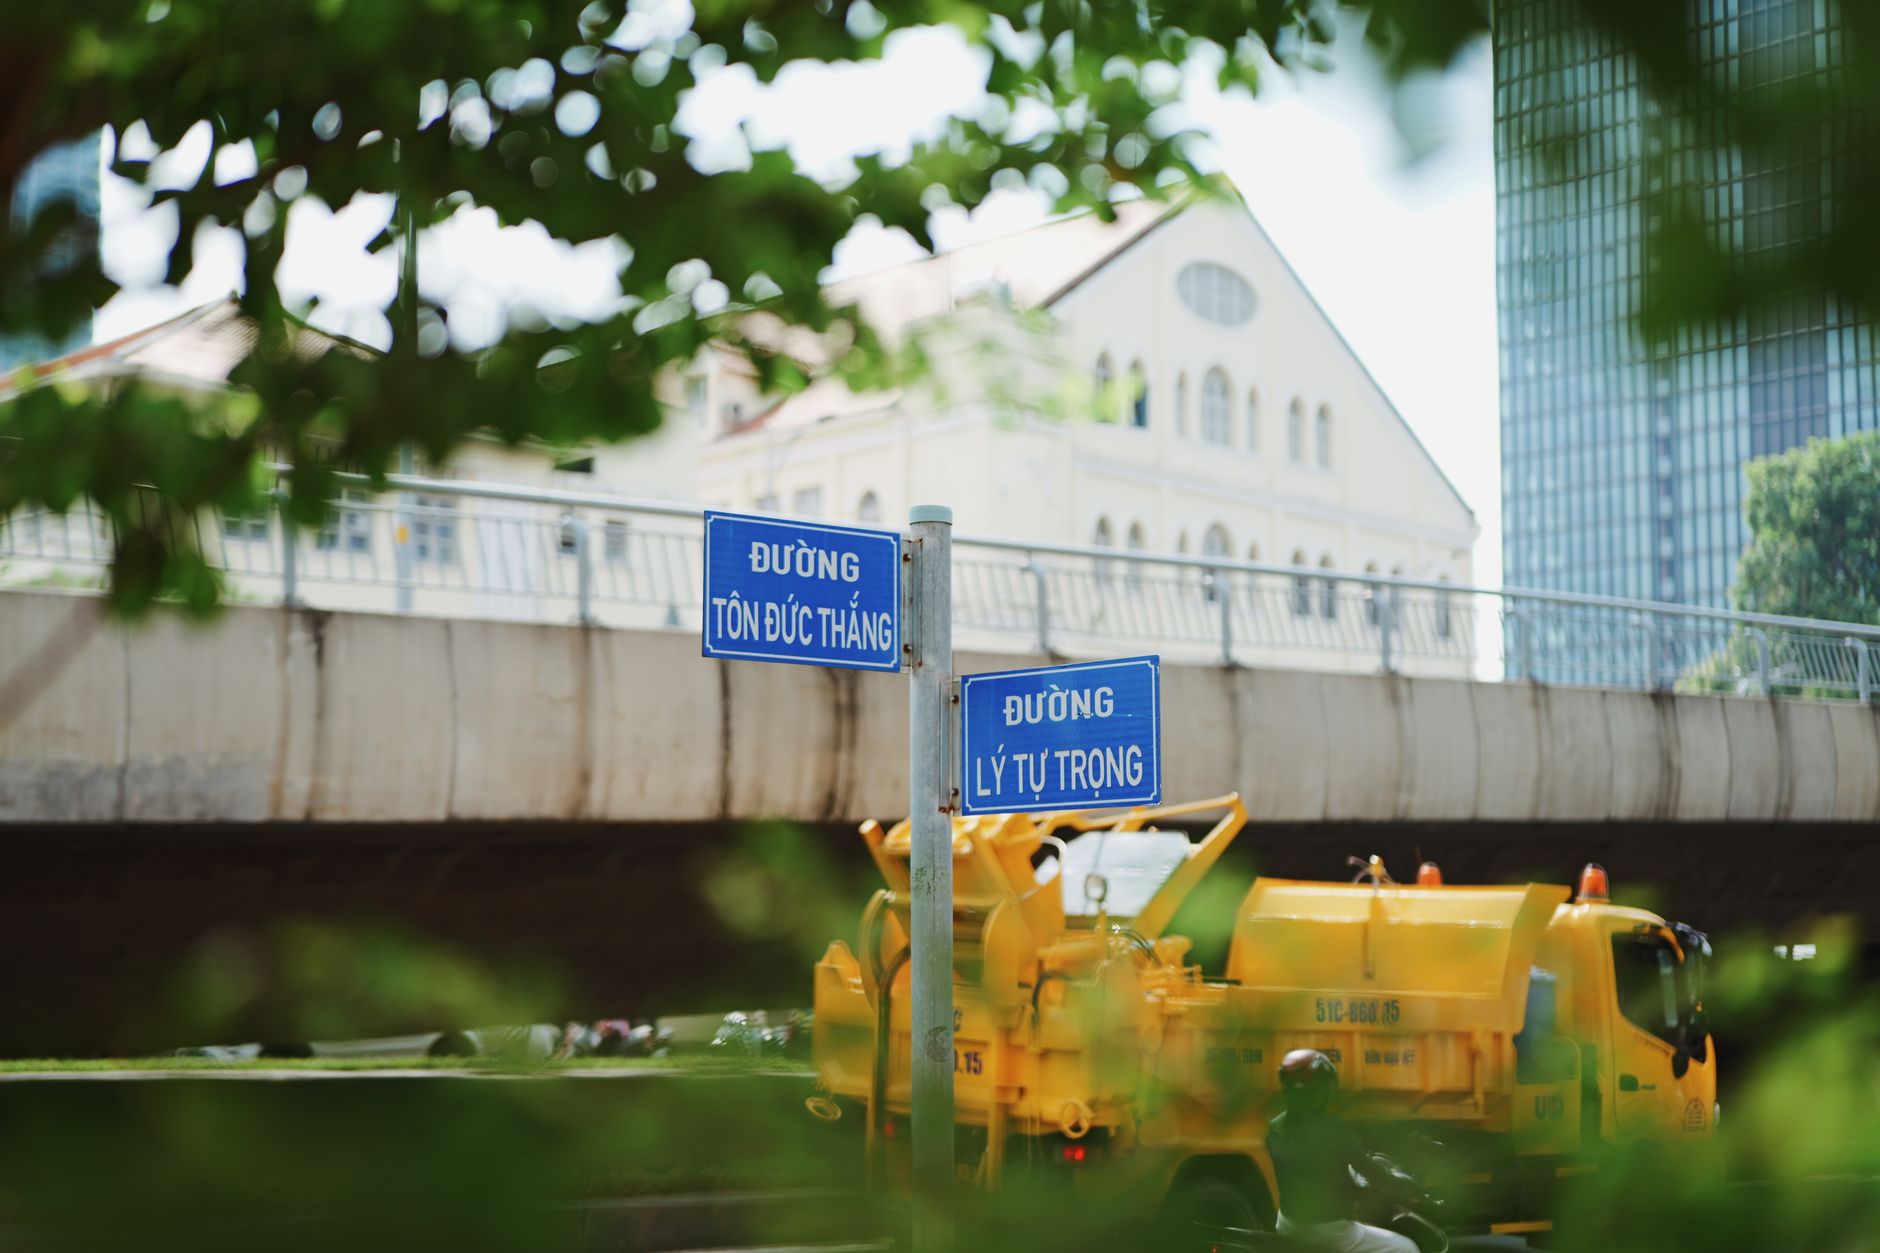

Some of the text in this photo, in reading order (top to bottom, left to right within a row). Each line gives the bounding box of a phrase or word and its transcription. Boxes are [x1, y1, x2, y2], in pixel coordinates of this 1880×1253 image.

[749, 539, 860, 583] ĐƯỜNG
[712, 590, 892, 651] TÔN ĐỨC THẮNG
[1003, 684, 1114, 727] ĐƯỜNG
[976, 743, 1143, 801] LÝ TỰ TRỌNG
